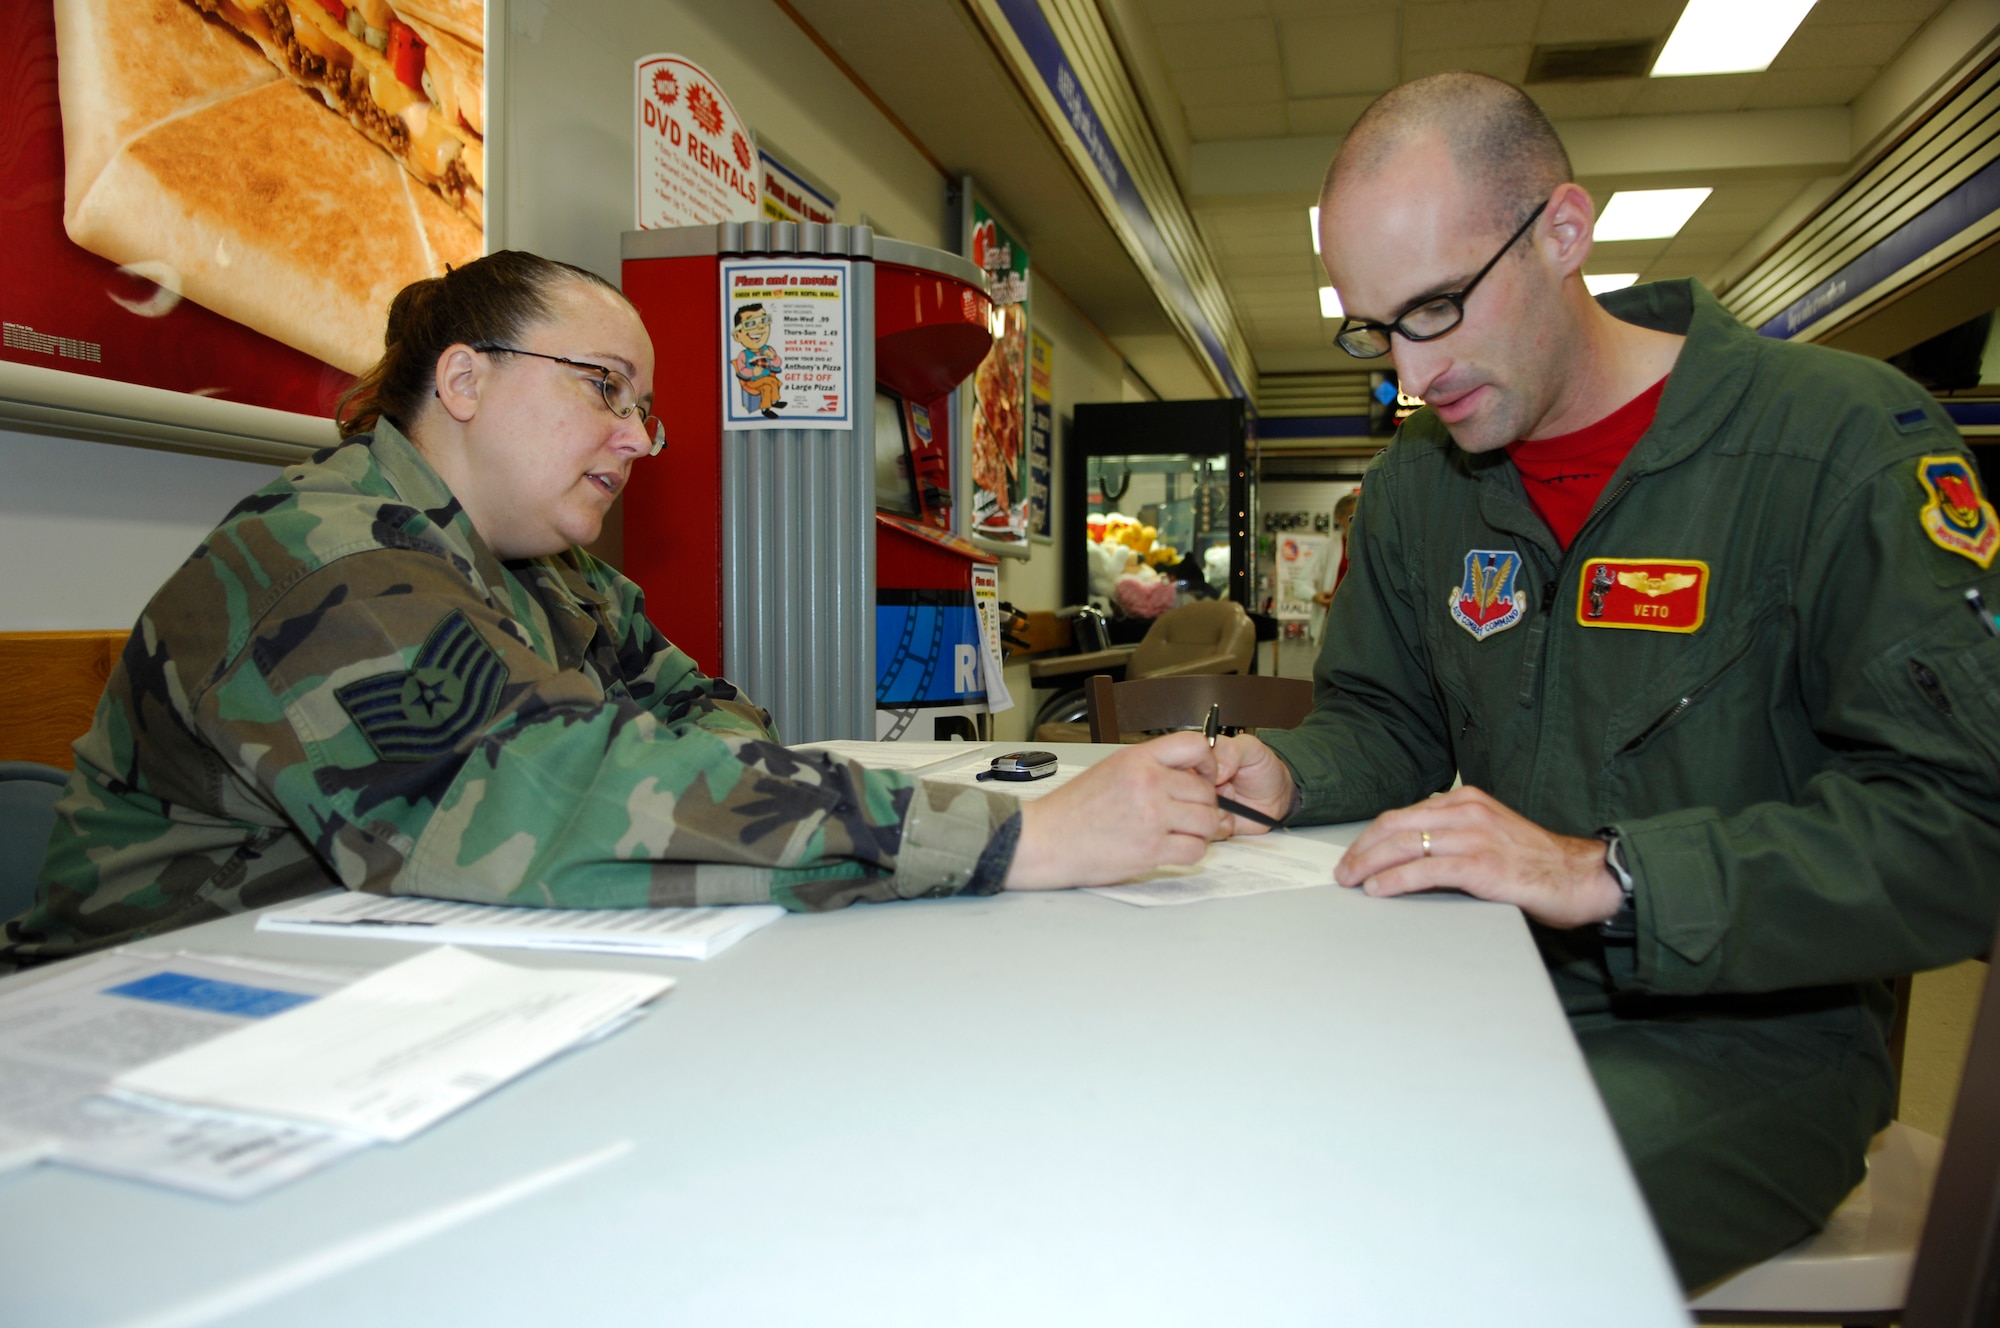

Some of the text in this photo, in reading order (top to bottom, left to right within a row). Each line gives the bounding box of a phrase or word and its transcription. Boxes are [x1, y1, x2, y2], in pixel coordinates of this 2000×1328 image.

[644, 98, 681, 146] DVD
[688, 132, 756, 205] RENTALS
[735, 275, 764, 287] Pizza
[766, 274, 788, 286] and
[790, 276, 798, 286] a
[784, 364, 820, 372] Anthony's
[784, 373, 832, 382] GET $2 OFF
[792, 384, 812, 392] Large
[1634, 604, 1669, 618] VETO
[1453, 606, 1519, 636] AIR COMBAT COMMAND
